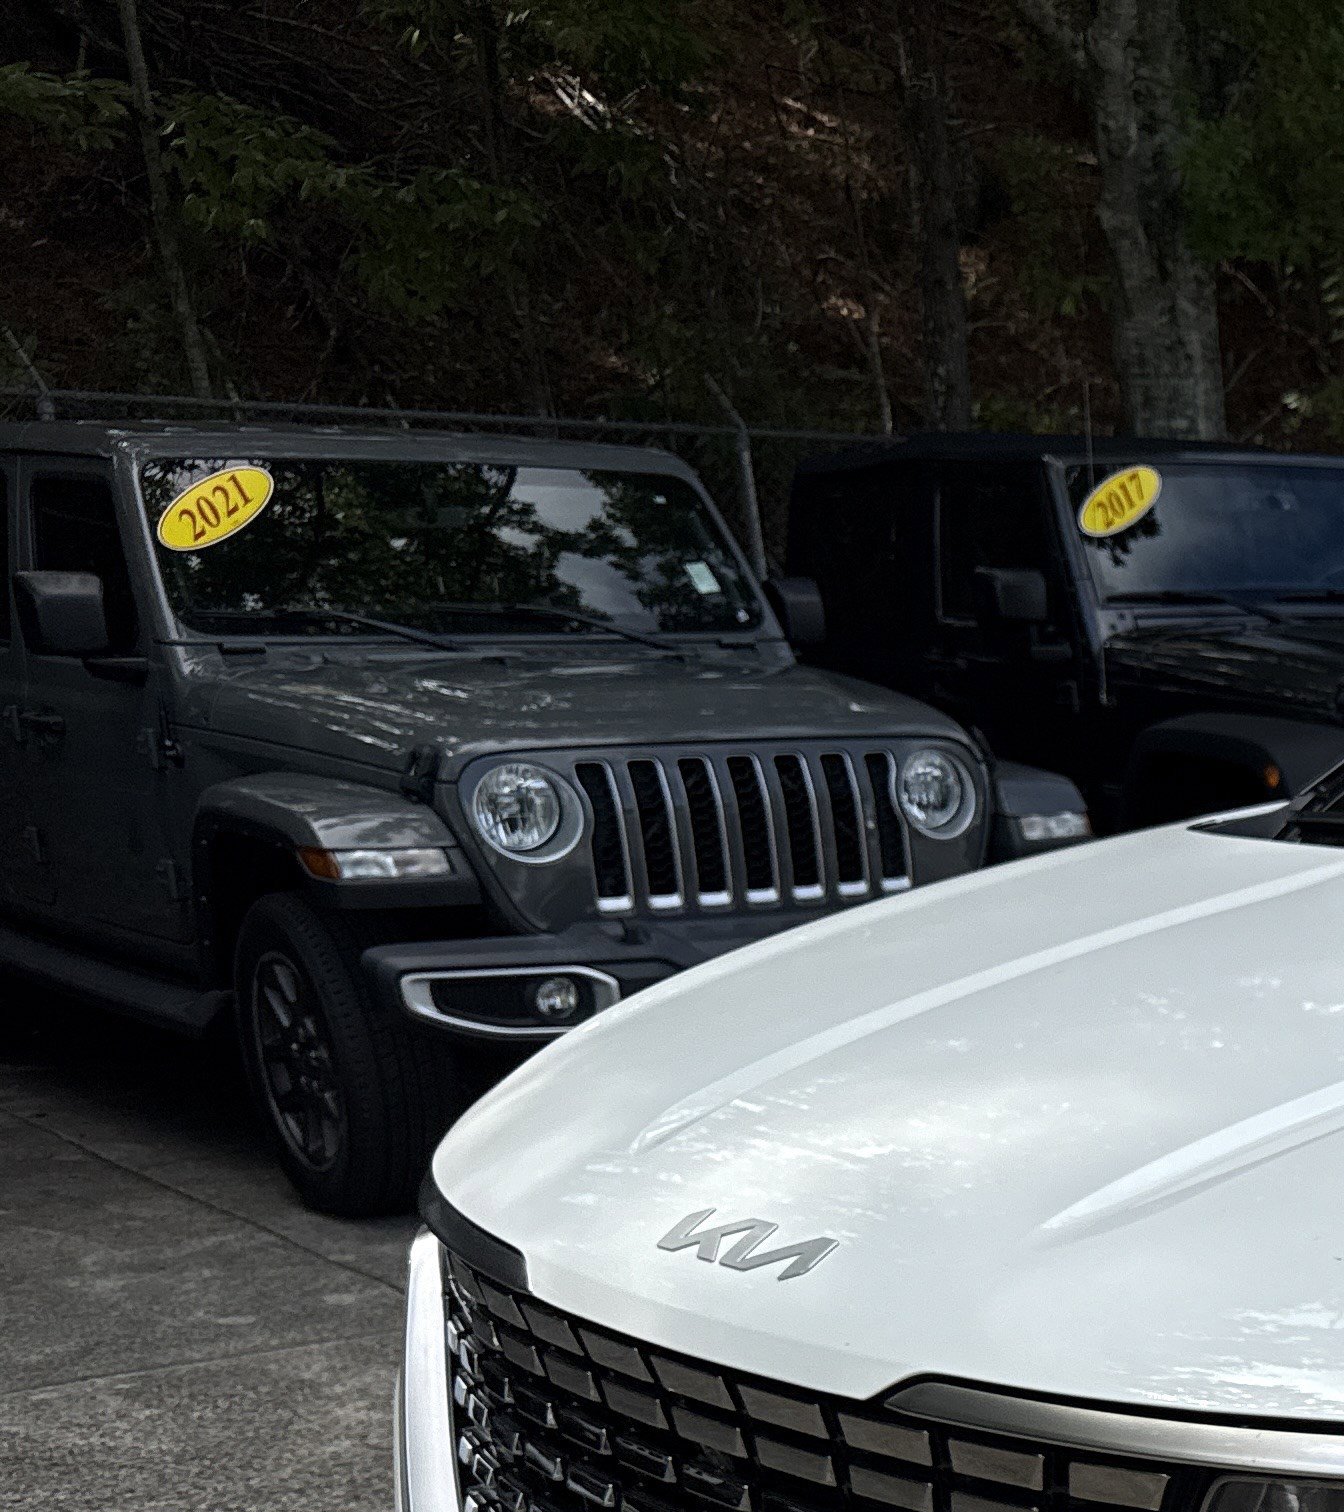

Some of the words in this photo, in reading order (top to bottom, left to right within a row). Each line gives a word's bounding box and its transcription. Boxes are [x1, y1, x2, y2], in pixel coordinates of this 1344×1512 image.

[178, 472, 255, 543] 2021
[1096, 471, 1145, 530] 2017
[656, 1206, 841, 1282] KIA
